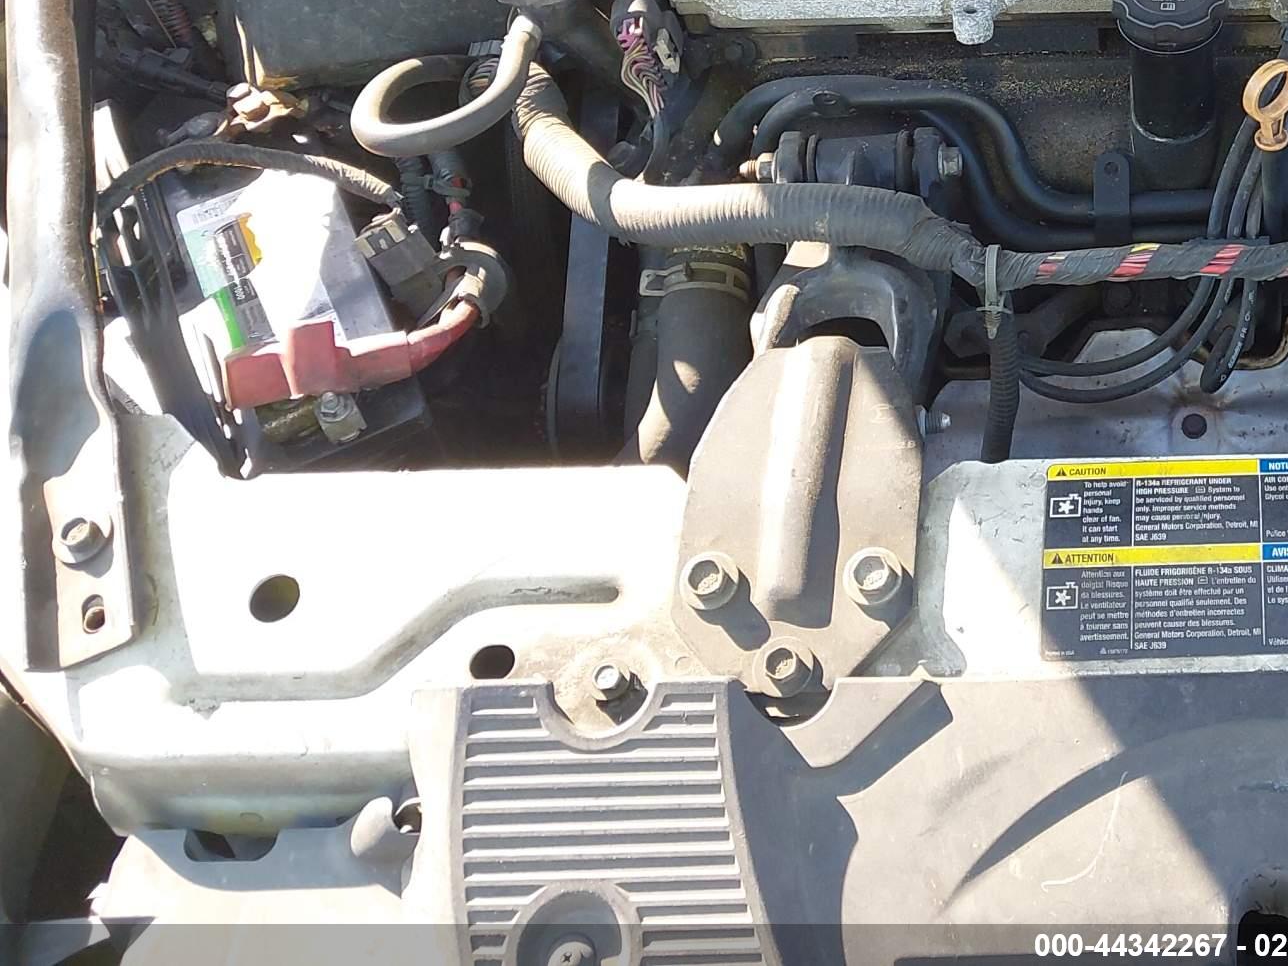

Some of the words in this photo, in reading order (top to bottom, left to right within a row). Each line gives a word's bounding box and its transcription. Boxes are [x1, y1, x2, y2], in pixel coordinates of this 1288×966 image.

[1069, 467, 1106, 476] CAUTION
[1093, 481, 1108, 489] help
[1161, 478, 1207, 486] REFRIGERANT
[1084, 489, 1112, 498] personal
[1154, 486, 1189, 494] PRESSURE
[1208, 486, 1232, 494] System
[1083, 498, 1103, 507] injury,
[1104, 497, 1121, 506] keep
[1174, 496, 1183, 504] by
[1184, 495, 1212, 504] qualified
[1213, 494, 1245, 503] personnel
[1135, 505, 1151, 514] only.
[1152, 504, 1182, 513] Improper
[1065, 554, 1113, 563] ATTENTION
[1135, 578, 1158, 586] HAUTE
[1159, 578, 1194, 586] PRESSION
[1080, 633, 1129, 641] avertissement.
[1149, 641, 1167, 649] J639
